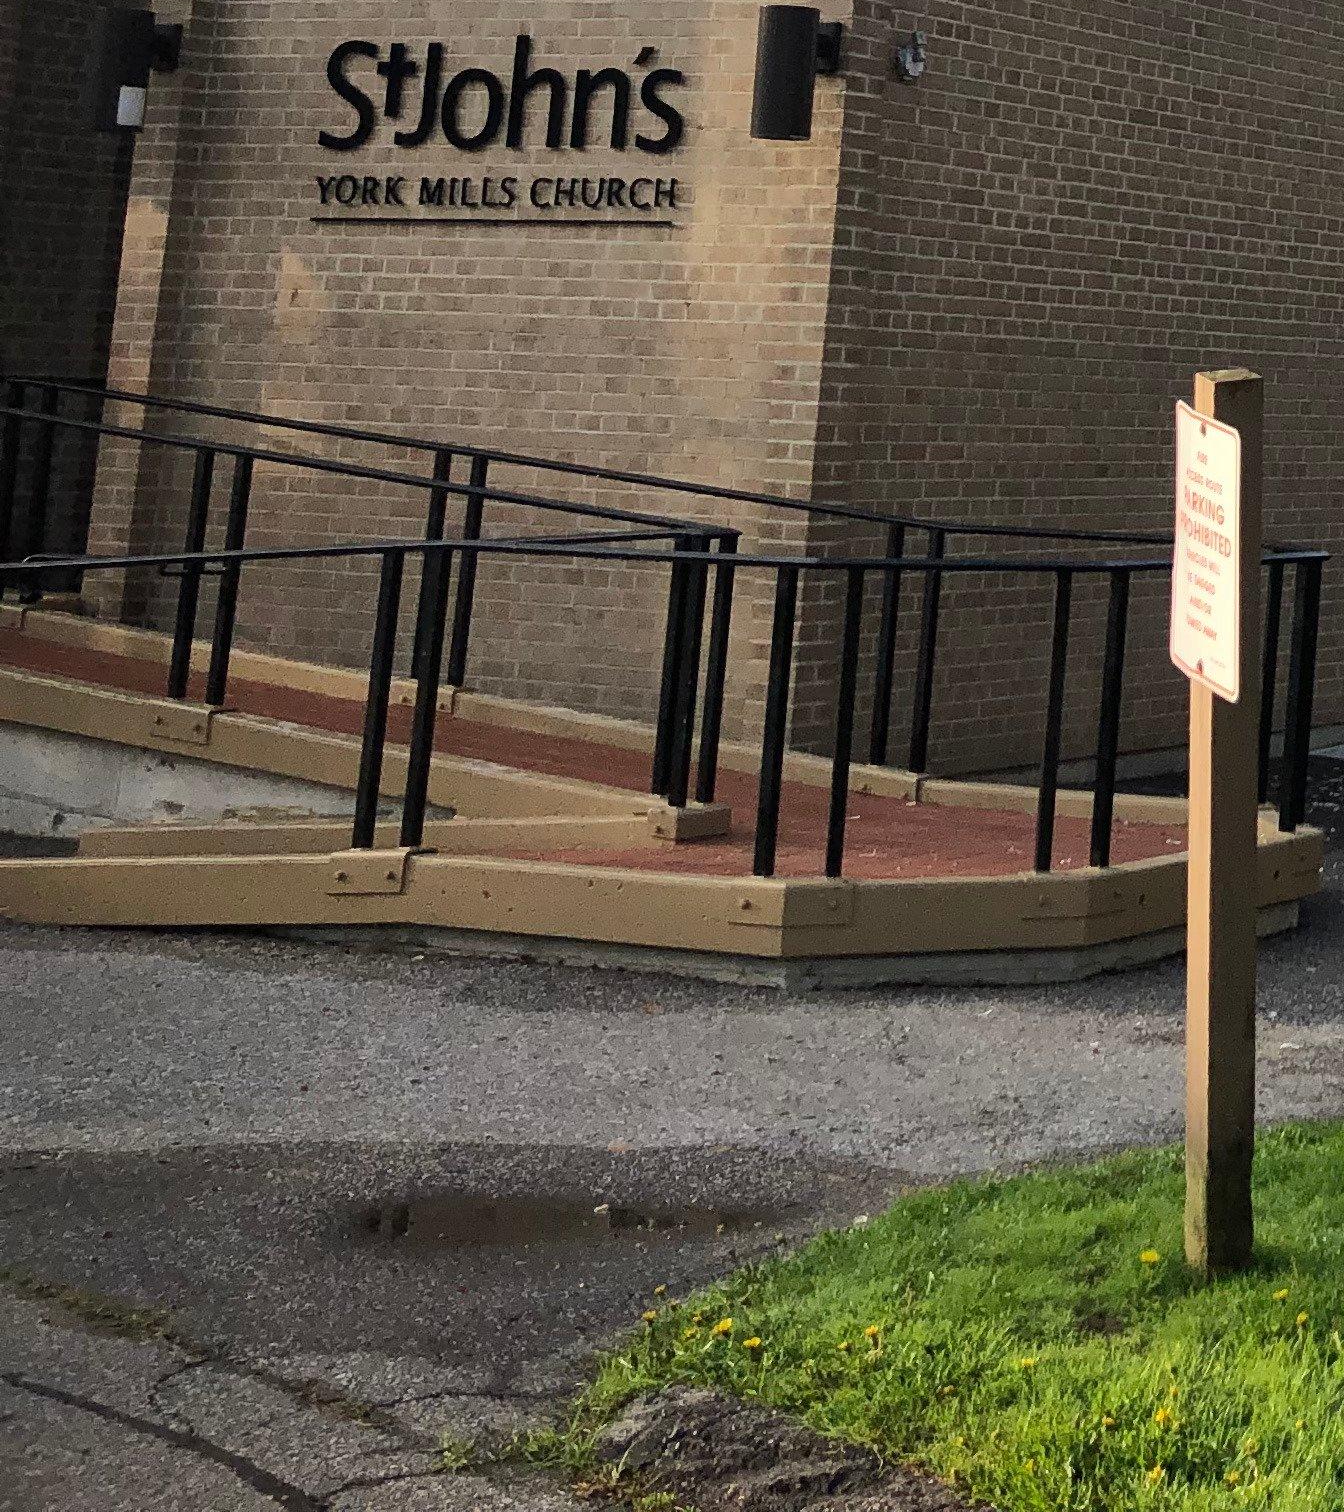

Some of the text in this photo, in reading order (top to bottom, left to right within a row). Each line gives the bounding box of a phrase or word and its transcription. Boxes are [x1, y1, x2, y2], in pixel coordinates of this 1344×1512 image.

[316, 175, 679, 210] YORK MILLS CHURCH
[1184, 485, 1225, 526] ARKING
